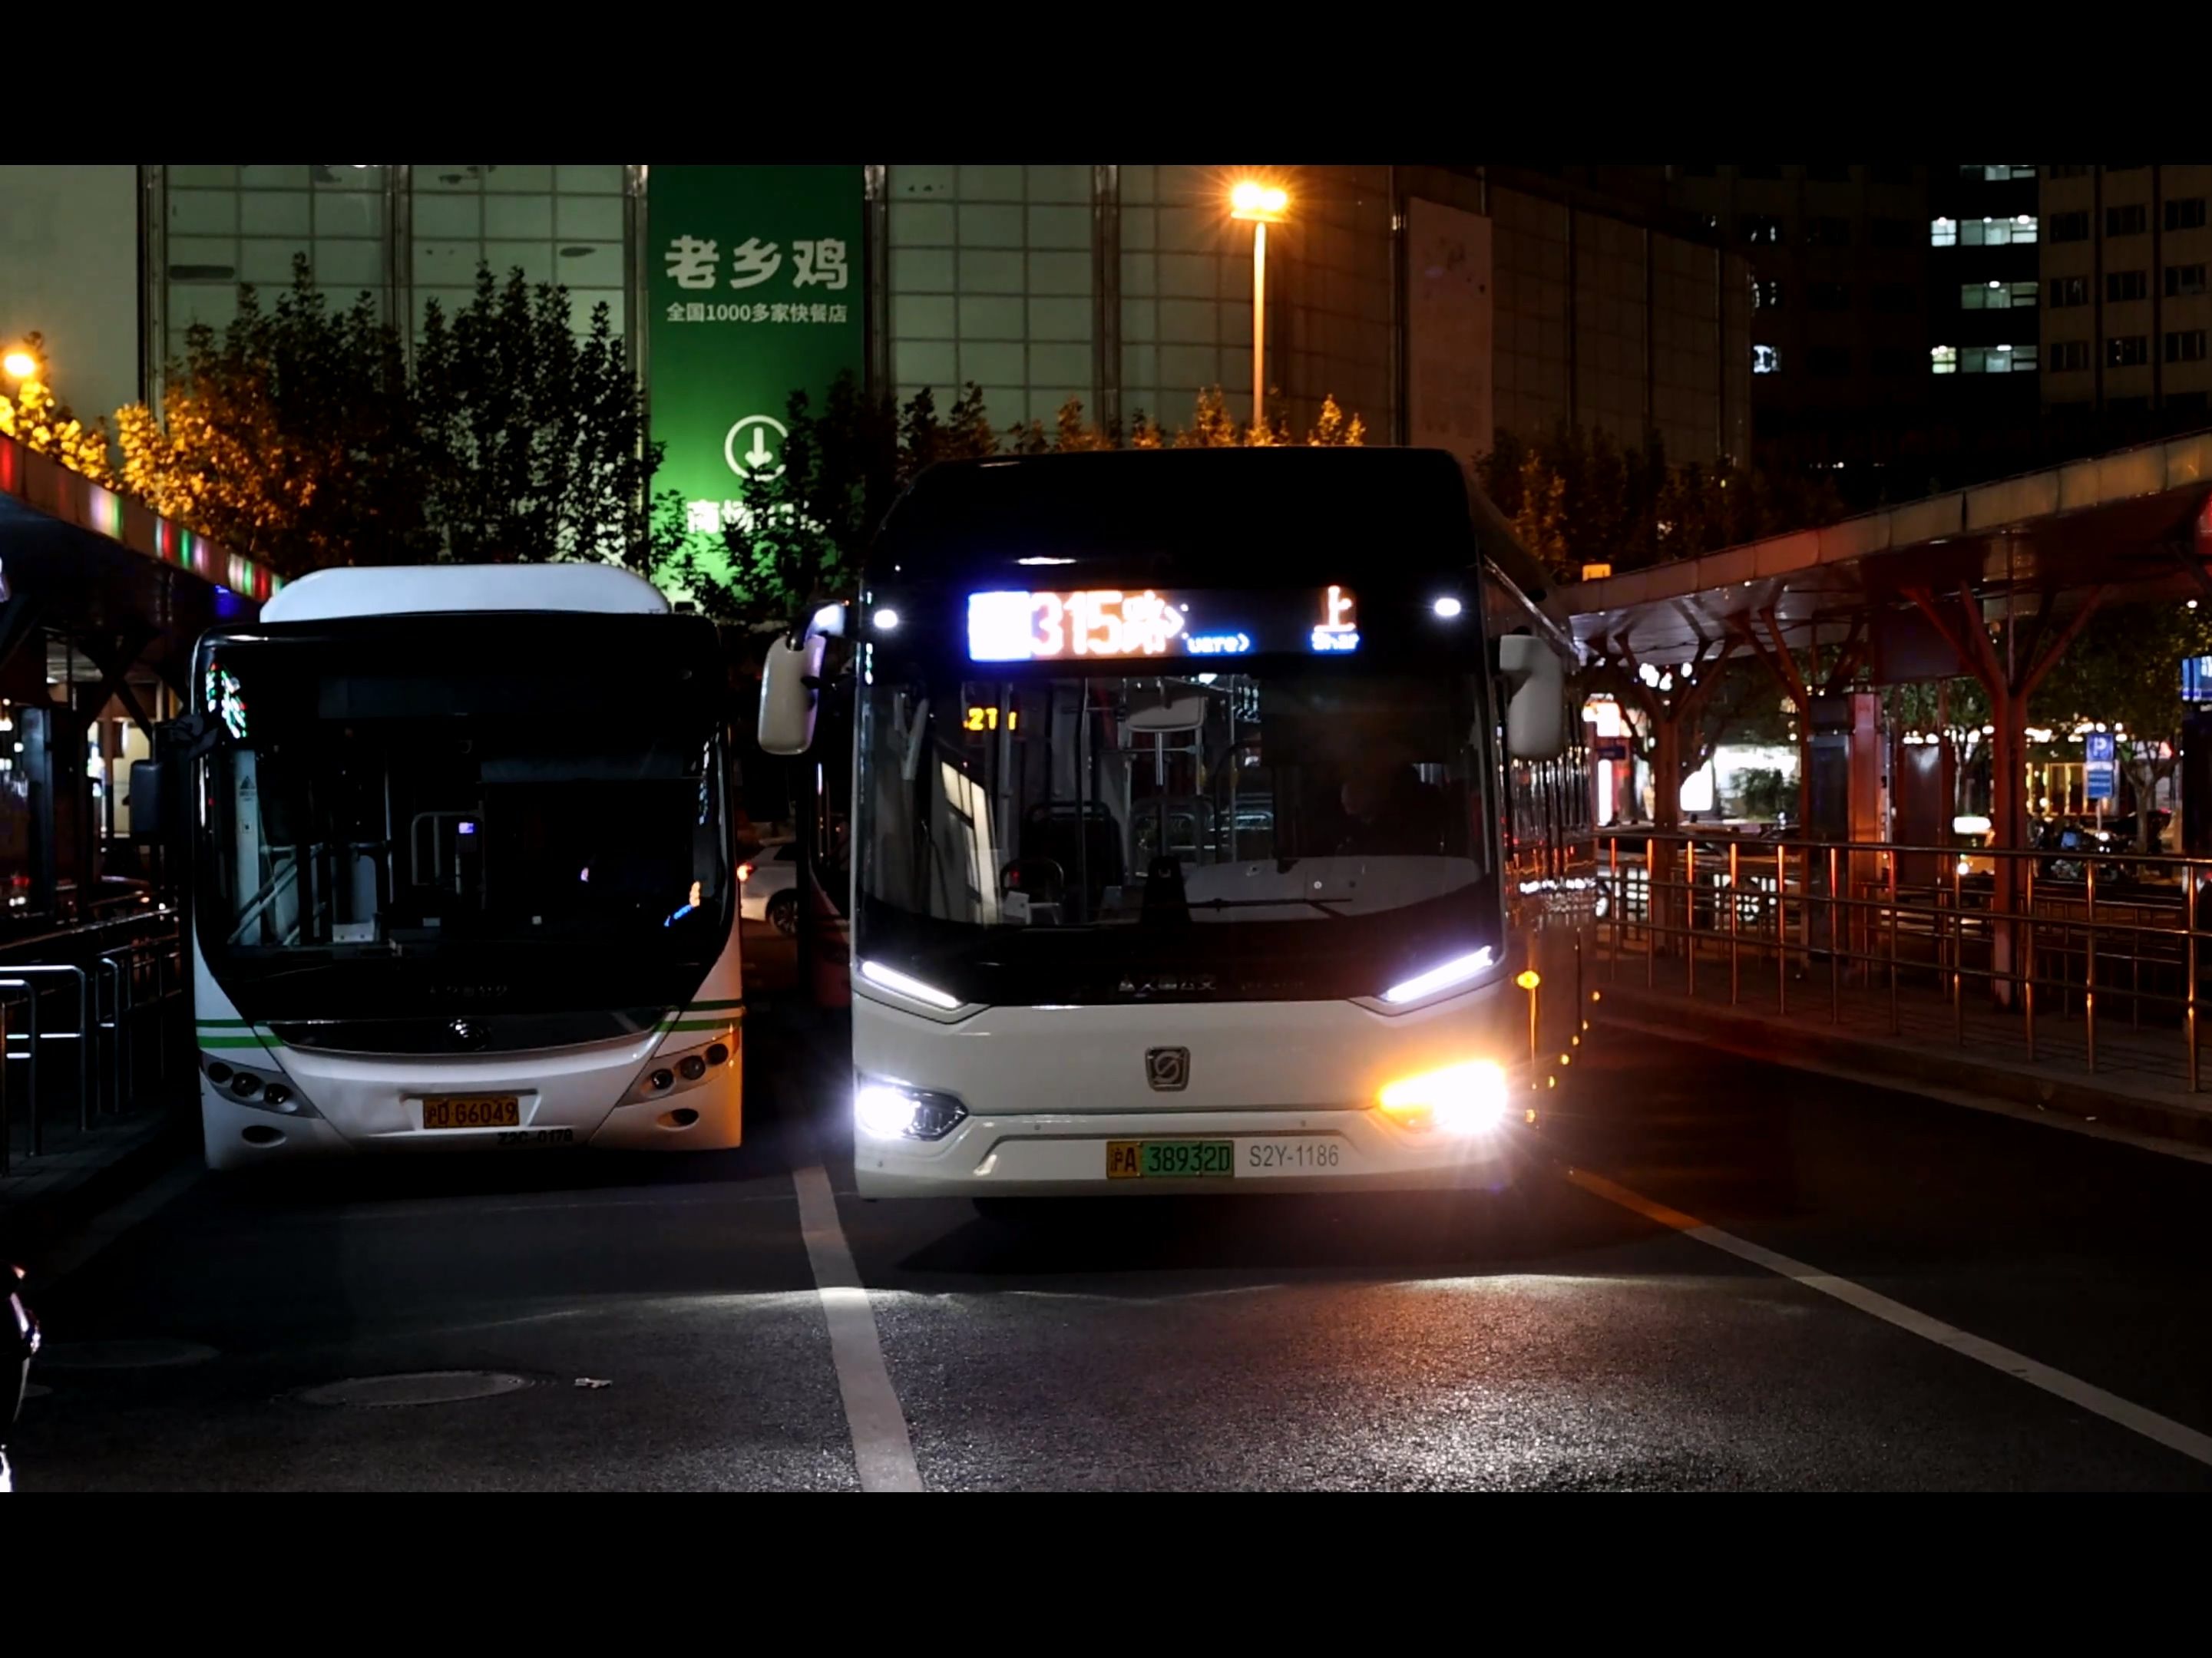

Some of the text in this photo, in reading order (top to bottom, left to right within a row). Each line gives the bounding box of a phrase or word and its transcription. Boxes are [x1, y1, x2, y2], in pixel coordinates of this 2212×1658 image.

[665, 234, 848, 290] 老乡鸡
[666, 302, 848, 323] 全国1000多家快餐店
[2093, 736, 2108, 757] P
[1249, 1144, 1340, 1168] S2Y-1186
